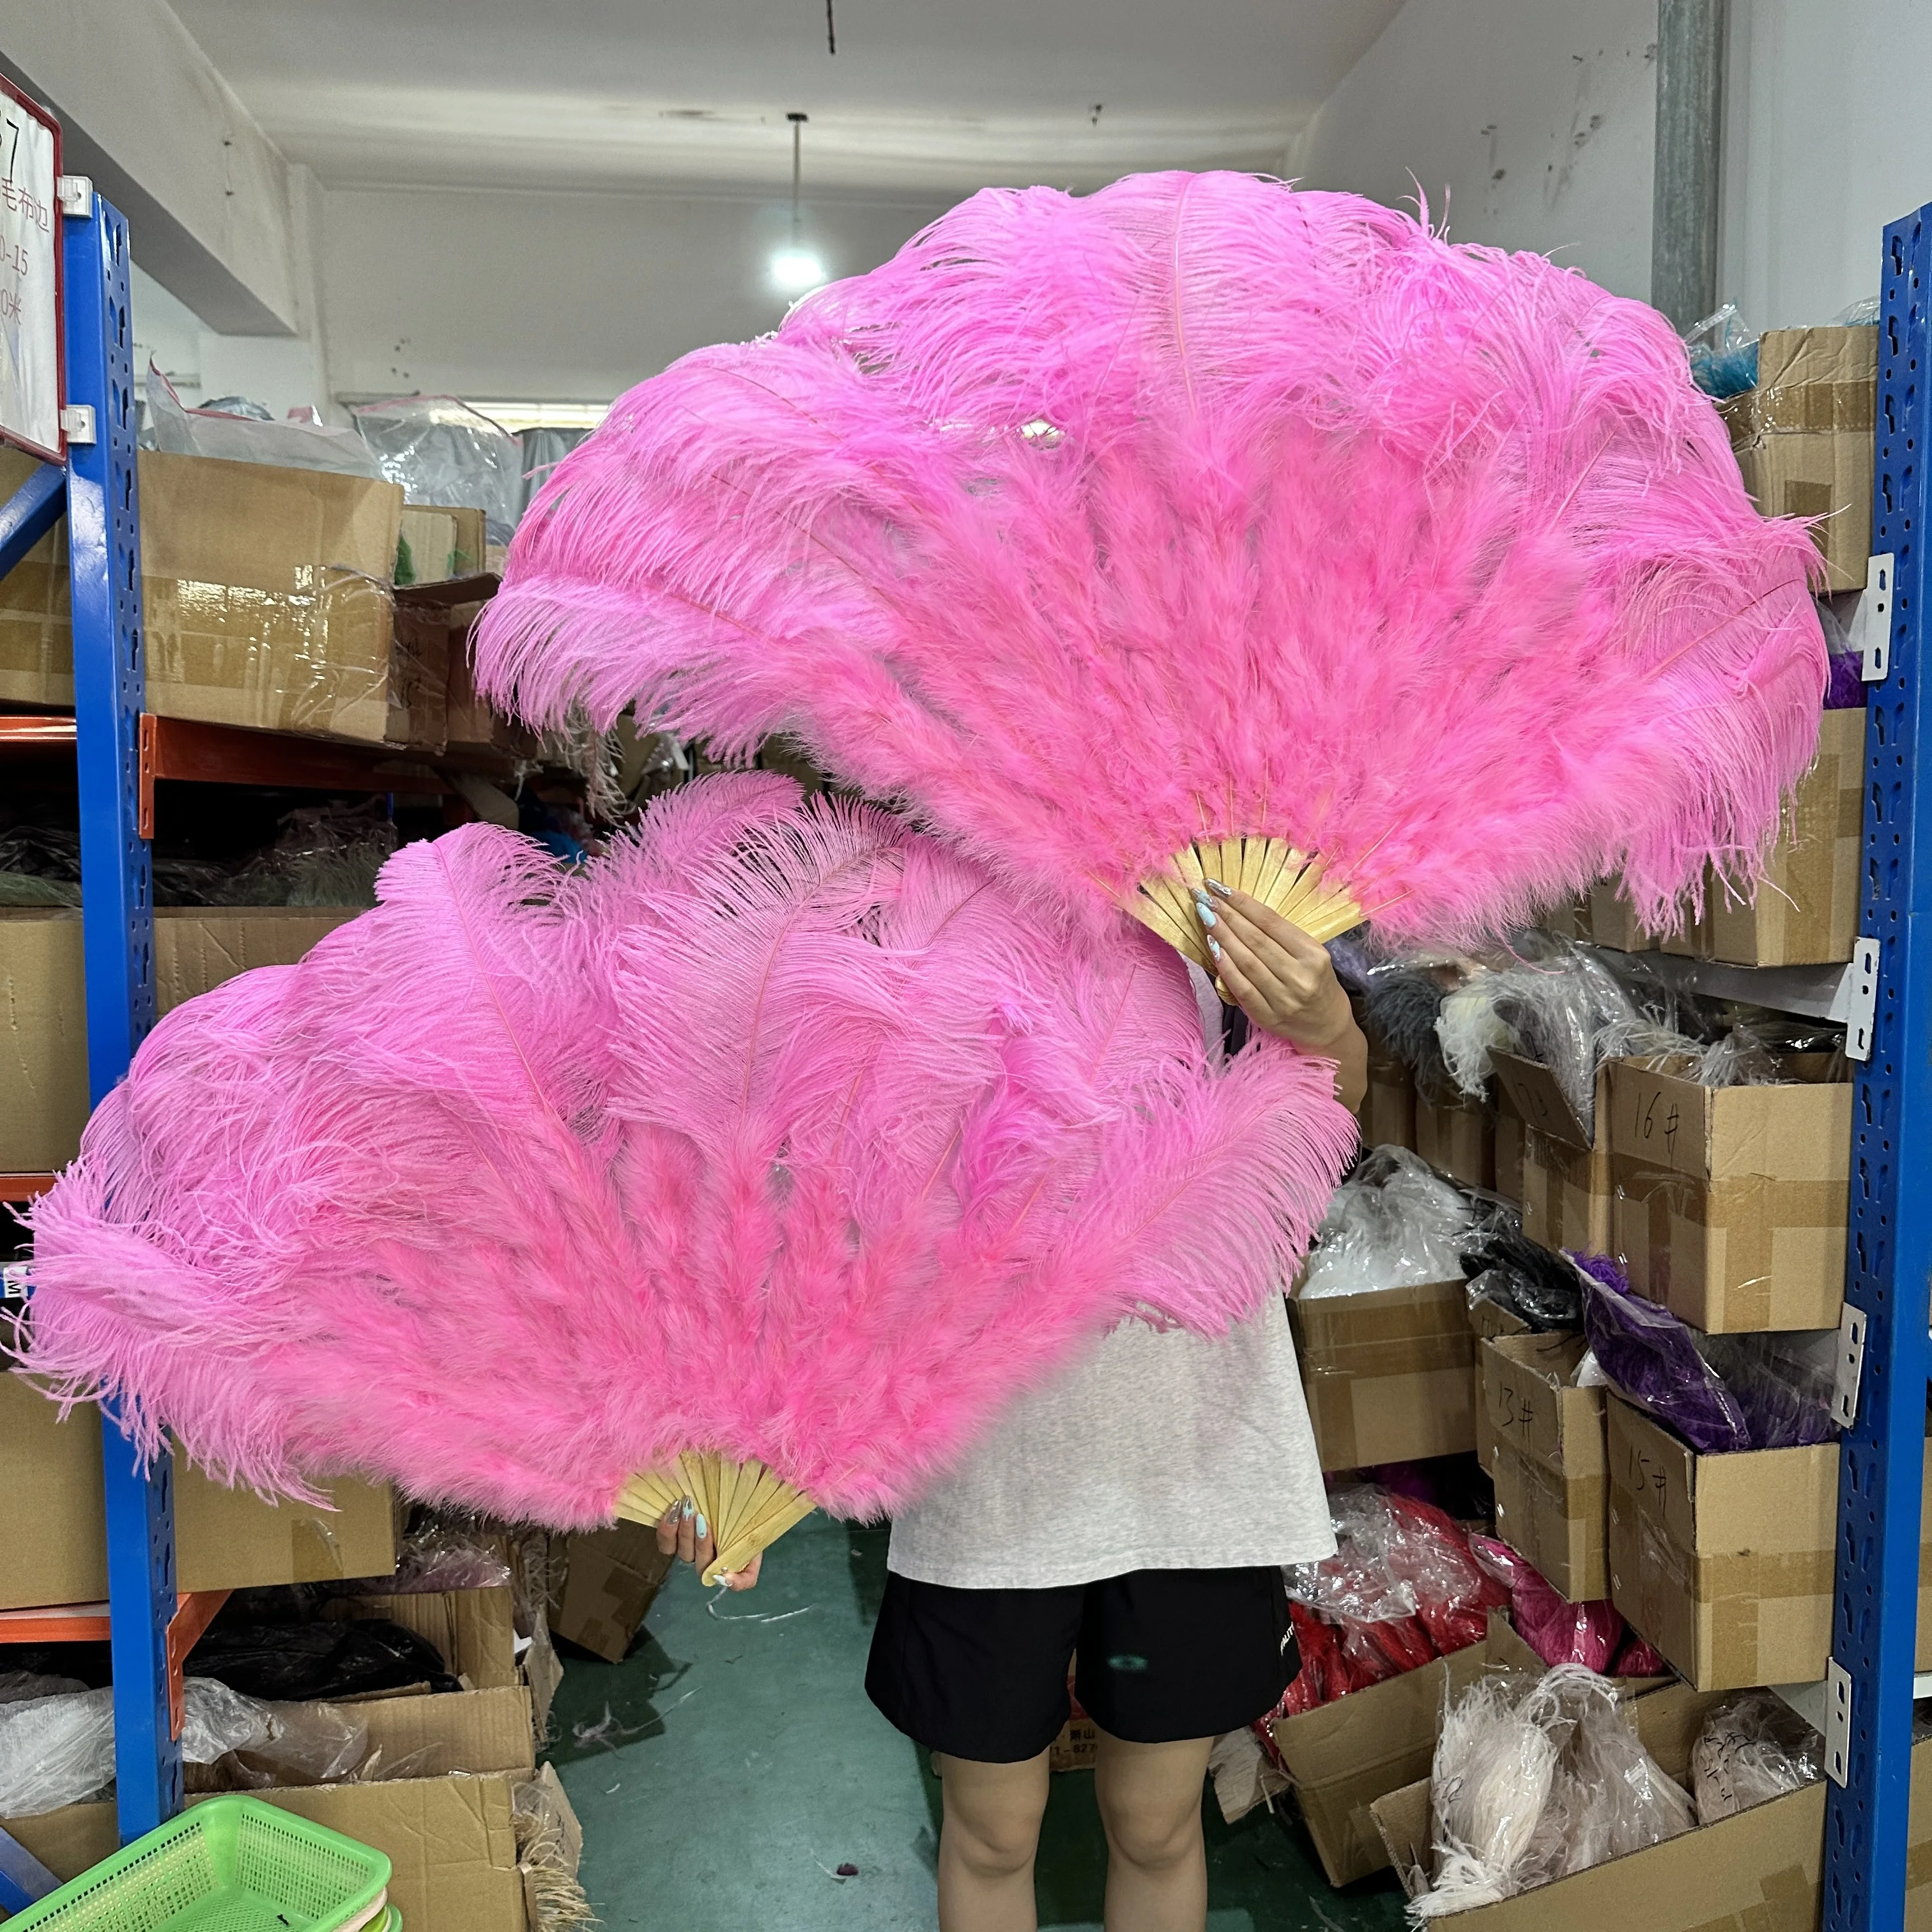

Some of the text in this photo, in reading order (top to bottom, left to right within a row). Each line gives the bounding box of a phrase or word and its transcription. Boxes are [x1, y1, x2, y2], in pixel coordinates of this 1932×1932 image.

[1635, 1091, 1679, 1169] 16#
[1499, 1381, 1533, 1456] 13#
[1629, 1445, 1666, 1519] 15#
